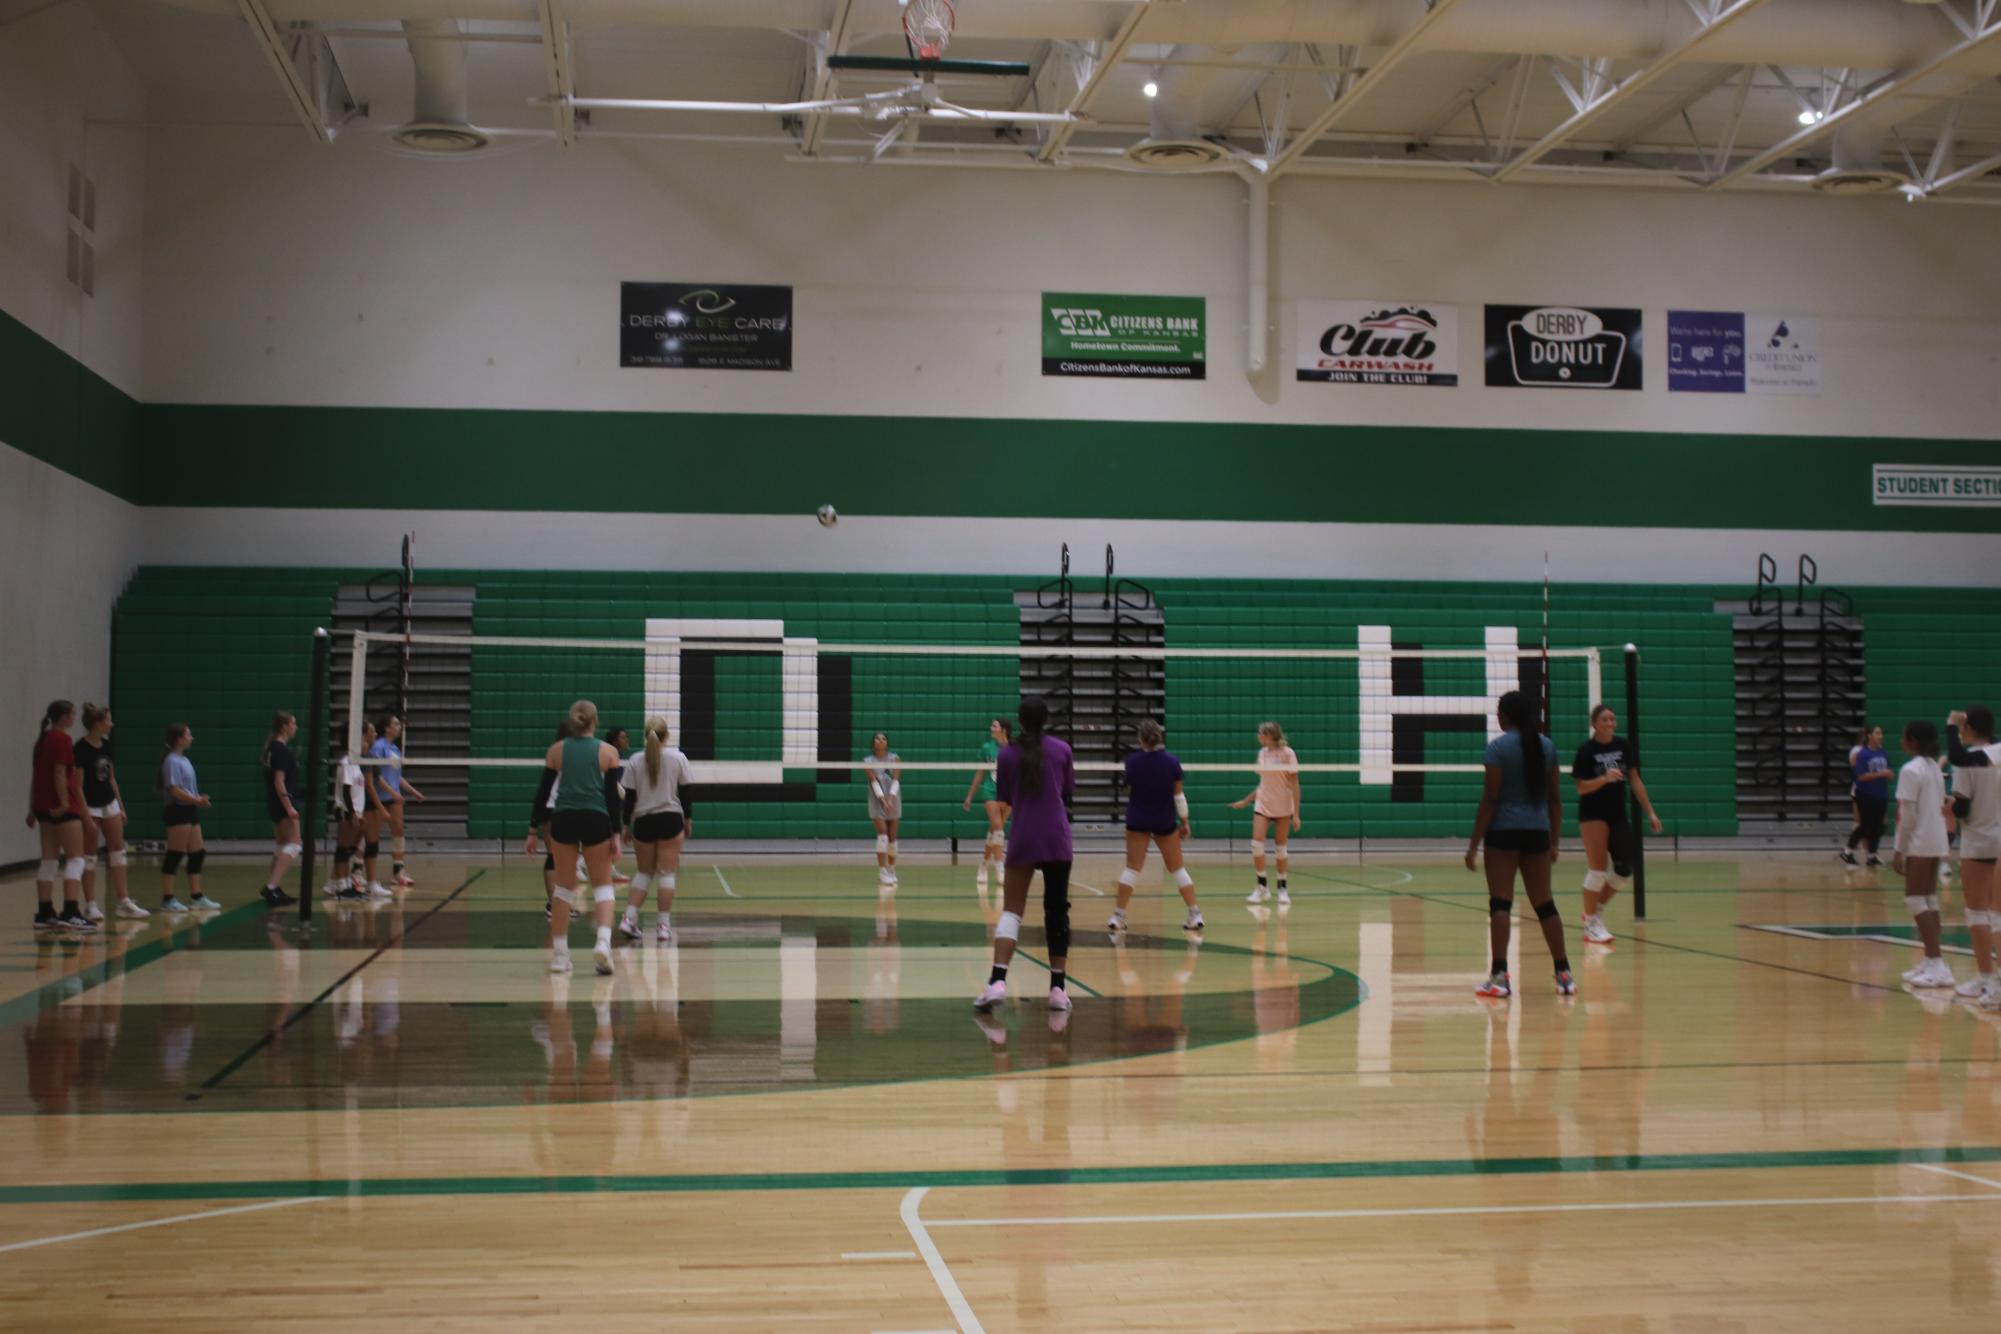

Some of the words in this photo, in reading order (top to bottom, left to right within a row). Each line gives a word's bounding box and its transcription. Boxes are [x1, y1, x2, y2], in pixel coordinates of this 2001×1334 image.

[695, 318, 729, 329] EYE
[734, 317, 785, 331] CARE
[1110, 315, 1163, 329] CITIZENS
[1166, 317, 1199, 330] BANK
[1537, 313, 1587, 335] DERBY
[1071, 340, 1120, 350] Hometown
[1320, 323, 1436, 360] Club
[1531, 341, 1606, 364] DONUT
[1060, 361, 1191, 375] CitizensBankofKansas.com
[1318, 358, 1434, 371] CARWASH
[1328, 371, 1358, 383] JOIN
[1361, 372, 1387, 384] THE
[1390, 373, 1428, 385] CLUB!
[1877, 476, 1949, 494] STUDENT
